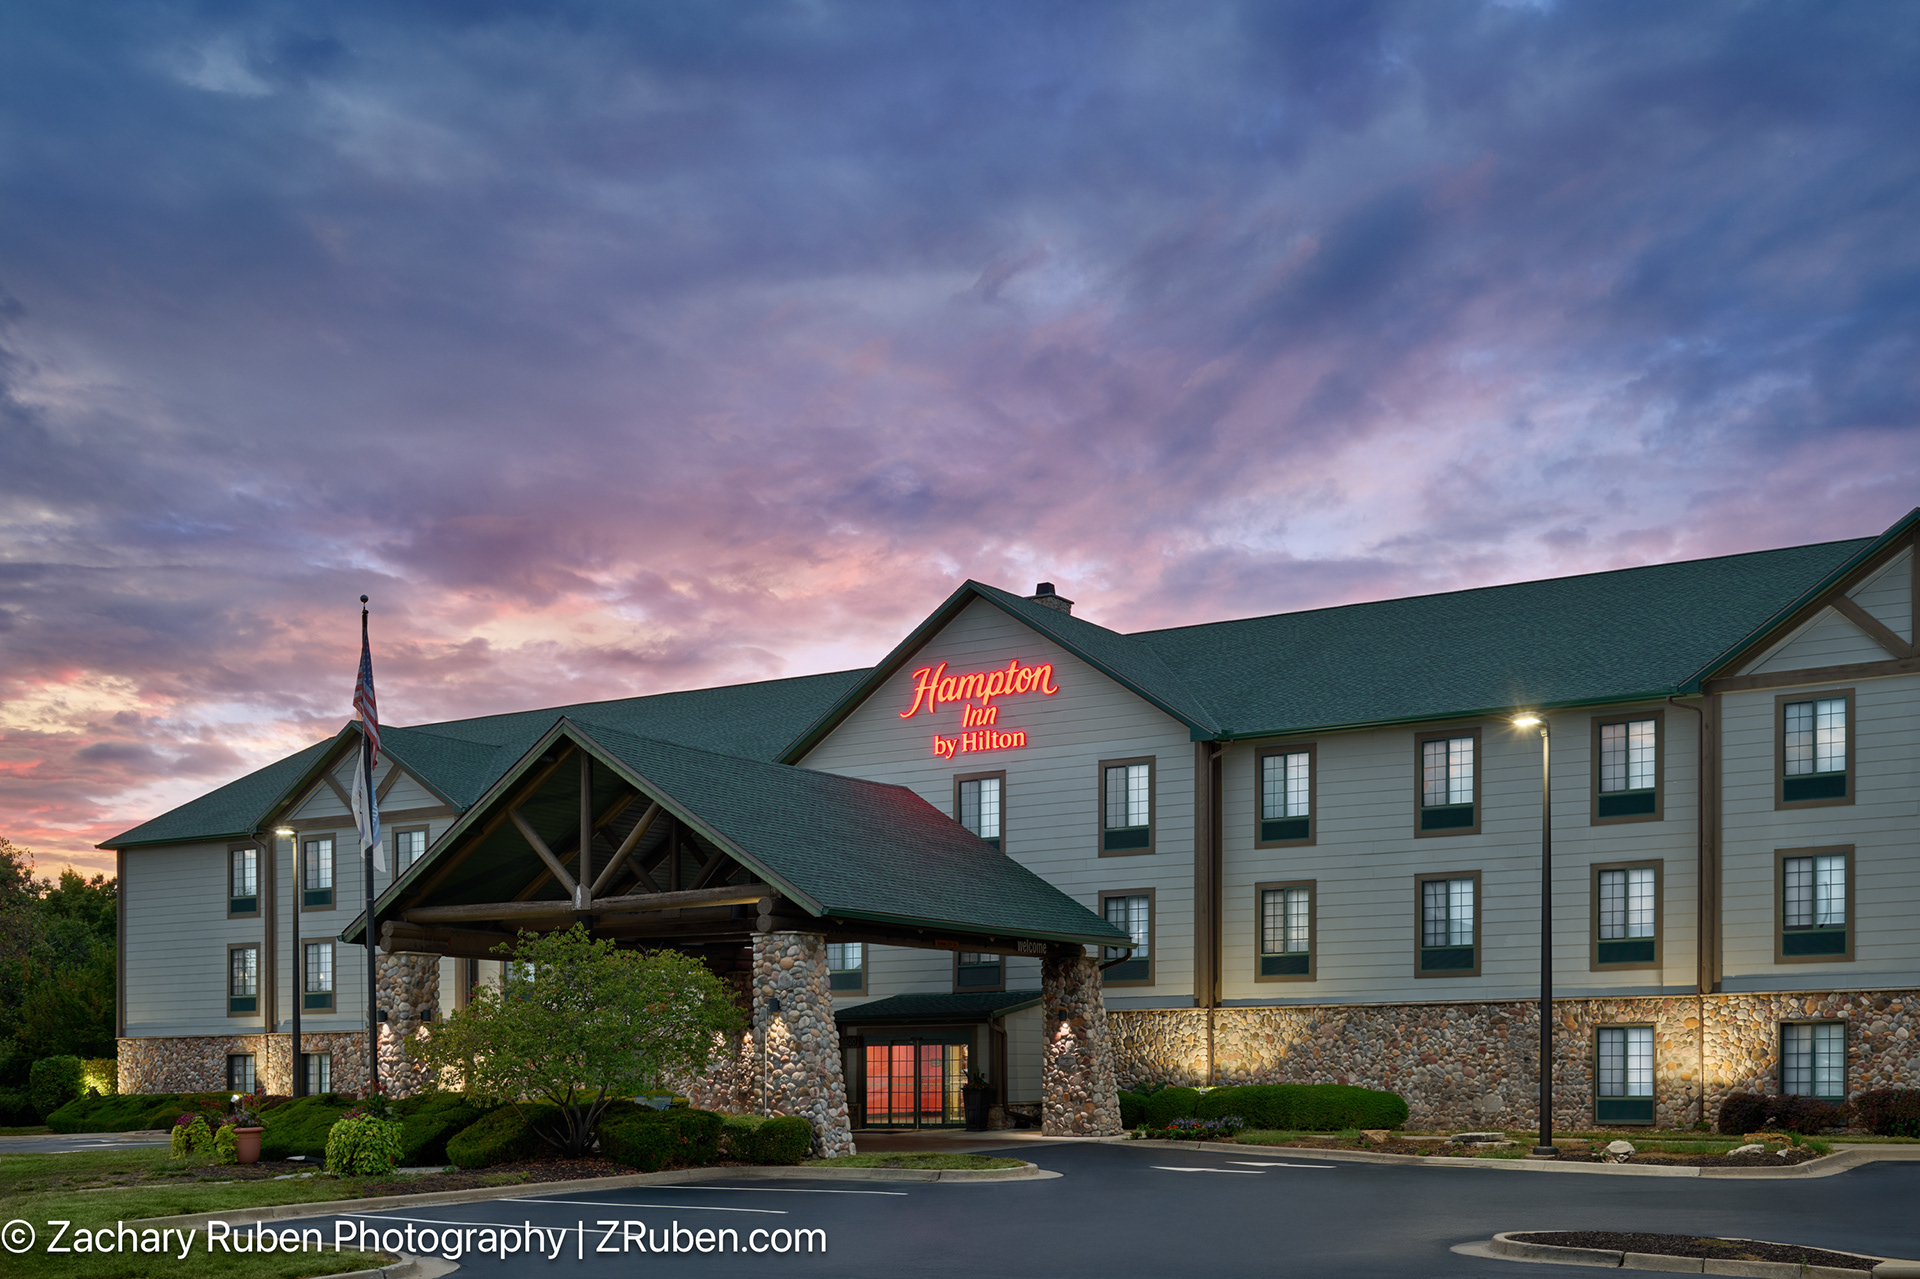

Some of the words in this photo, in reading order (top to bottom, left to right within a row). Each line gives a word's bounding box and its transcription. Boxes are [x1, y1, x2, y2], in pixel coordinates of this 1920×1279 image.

[899, 659, 1059, 719] Hampton
[962, 702, 998, 728] Inn
[933, 734, 959, 760] by
[961, 728, 1026, 753] Hilton
[1017, 939, 1047, 955] welcome
